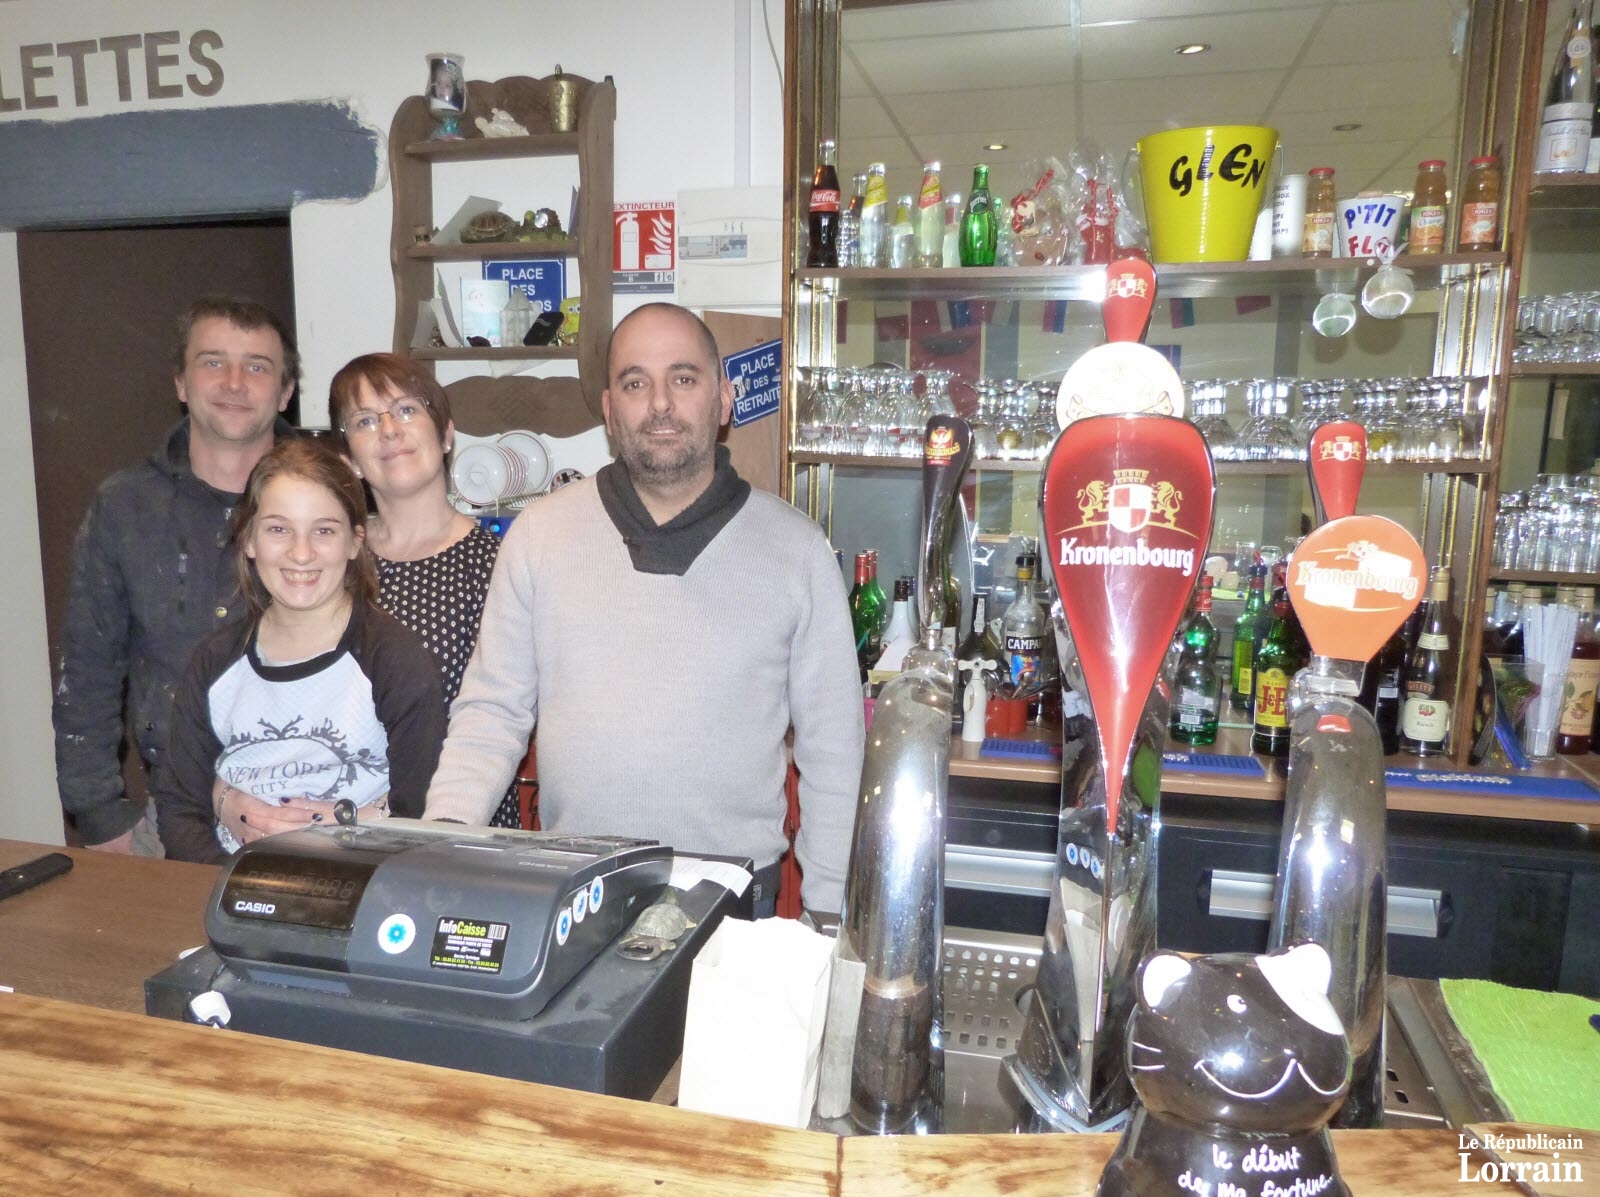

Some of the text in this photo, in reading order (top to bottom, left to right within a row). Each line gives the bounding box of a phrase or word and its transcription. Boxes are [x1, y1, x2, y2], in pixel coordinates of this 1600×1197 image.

[1169, 143, 1266, 197] GLEN
[612, 202, 674, 211] EXTINCTEUR
[502, 268, 544, 280] PLACE
[741, 353, 775, 377] PLACE
[753, 375, 769, 389] DES
[1059, 537, 1194, 577] Kronenbourg
[1295, 561, 1418, 600] Kronenbourg
[1007, 638, 1041, 650] CAMPA
[251, 780, 288, 795] CITY
[235, 901, 276, 914] CASIO
[439, 919, 487, 937] InfoCaisse
[1212, 1143, 1301, 1173] le début
